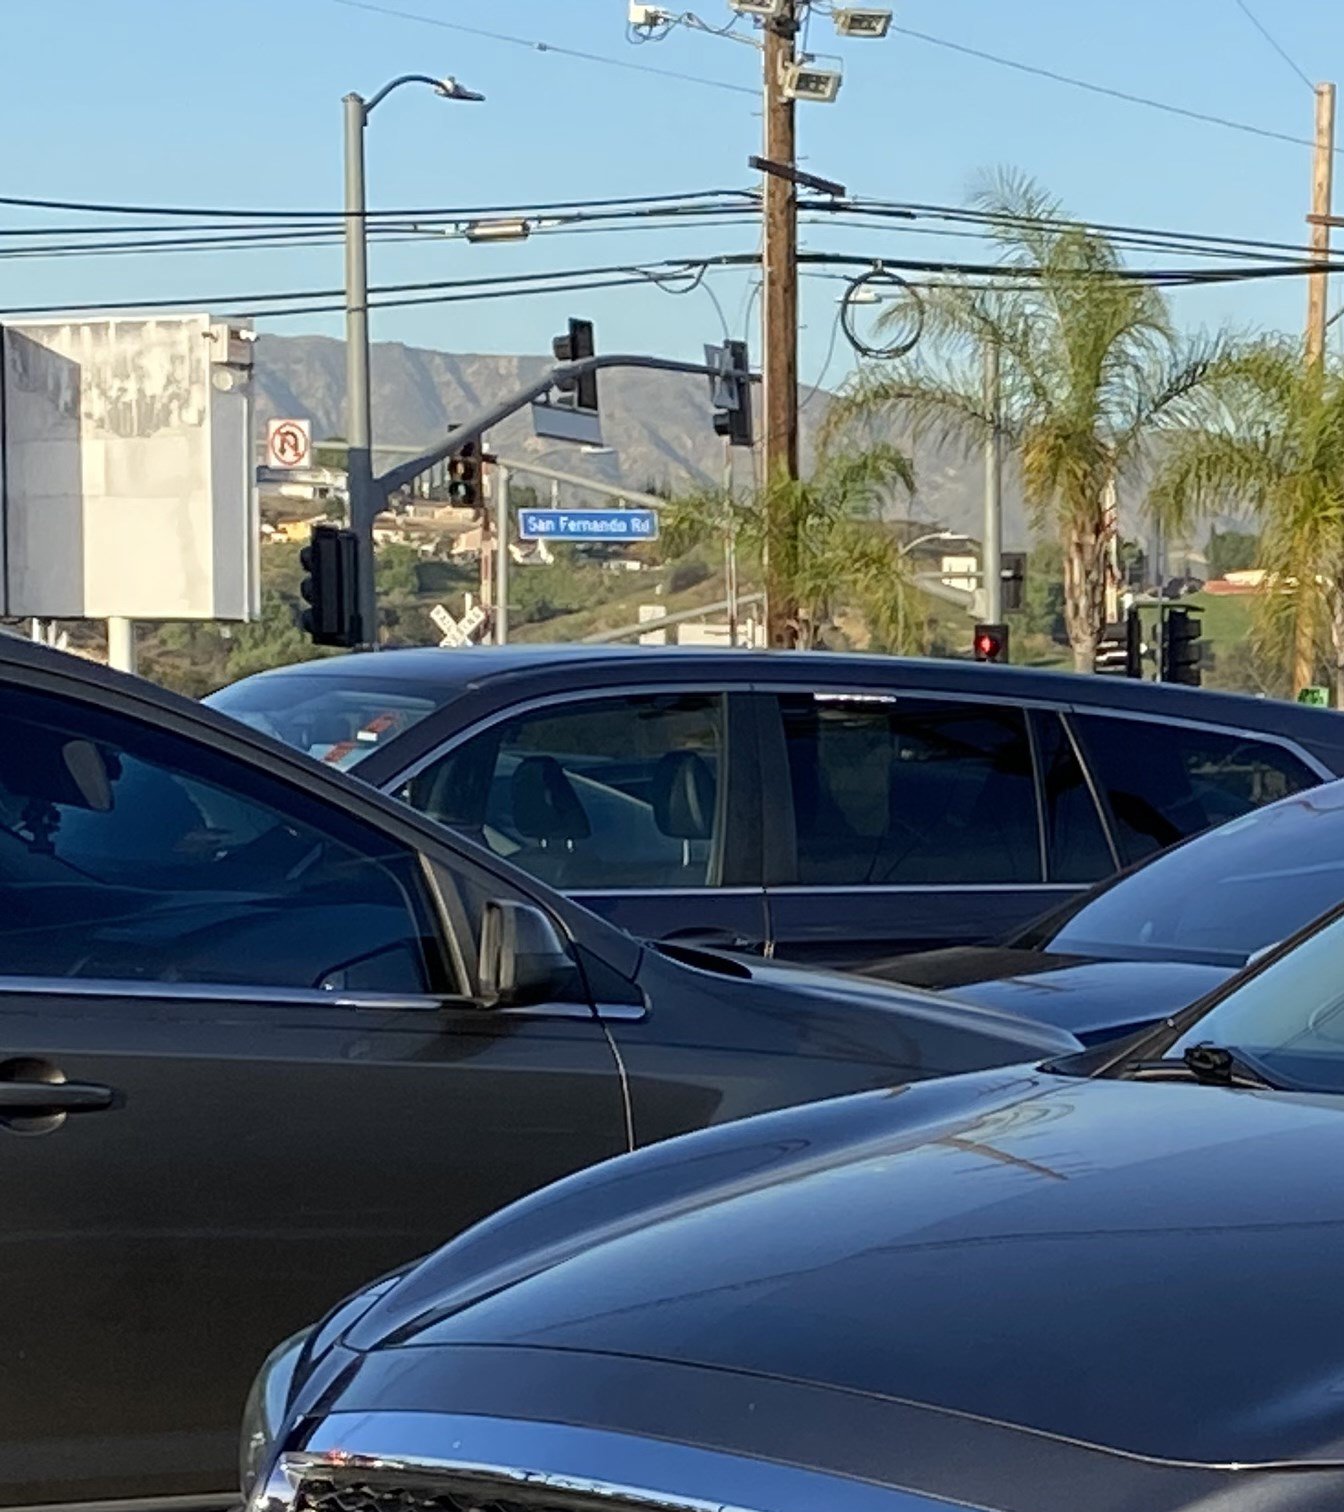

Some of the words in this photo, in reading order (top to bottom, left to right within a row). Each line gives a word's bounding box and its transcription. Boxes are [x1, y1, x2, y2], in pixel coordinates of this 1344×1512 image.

[527, 516, 555, 532] San
[559, 516, 627, 533] Fernando
[631, 517, 650, 533] Rd
